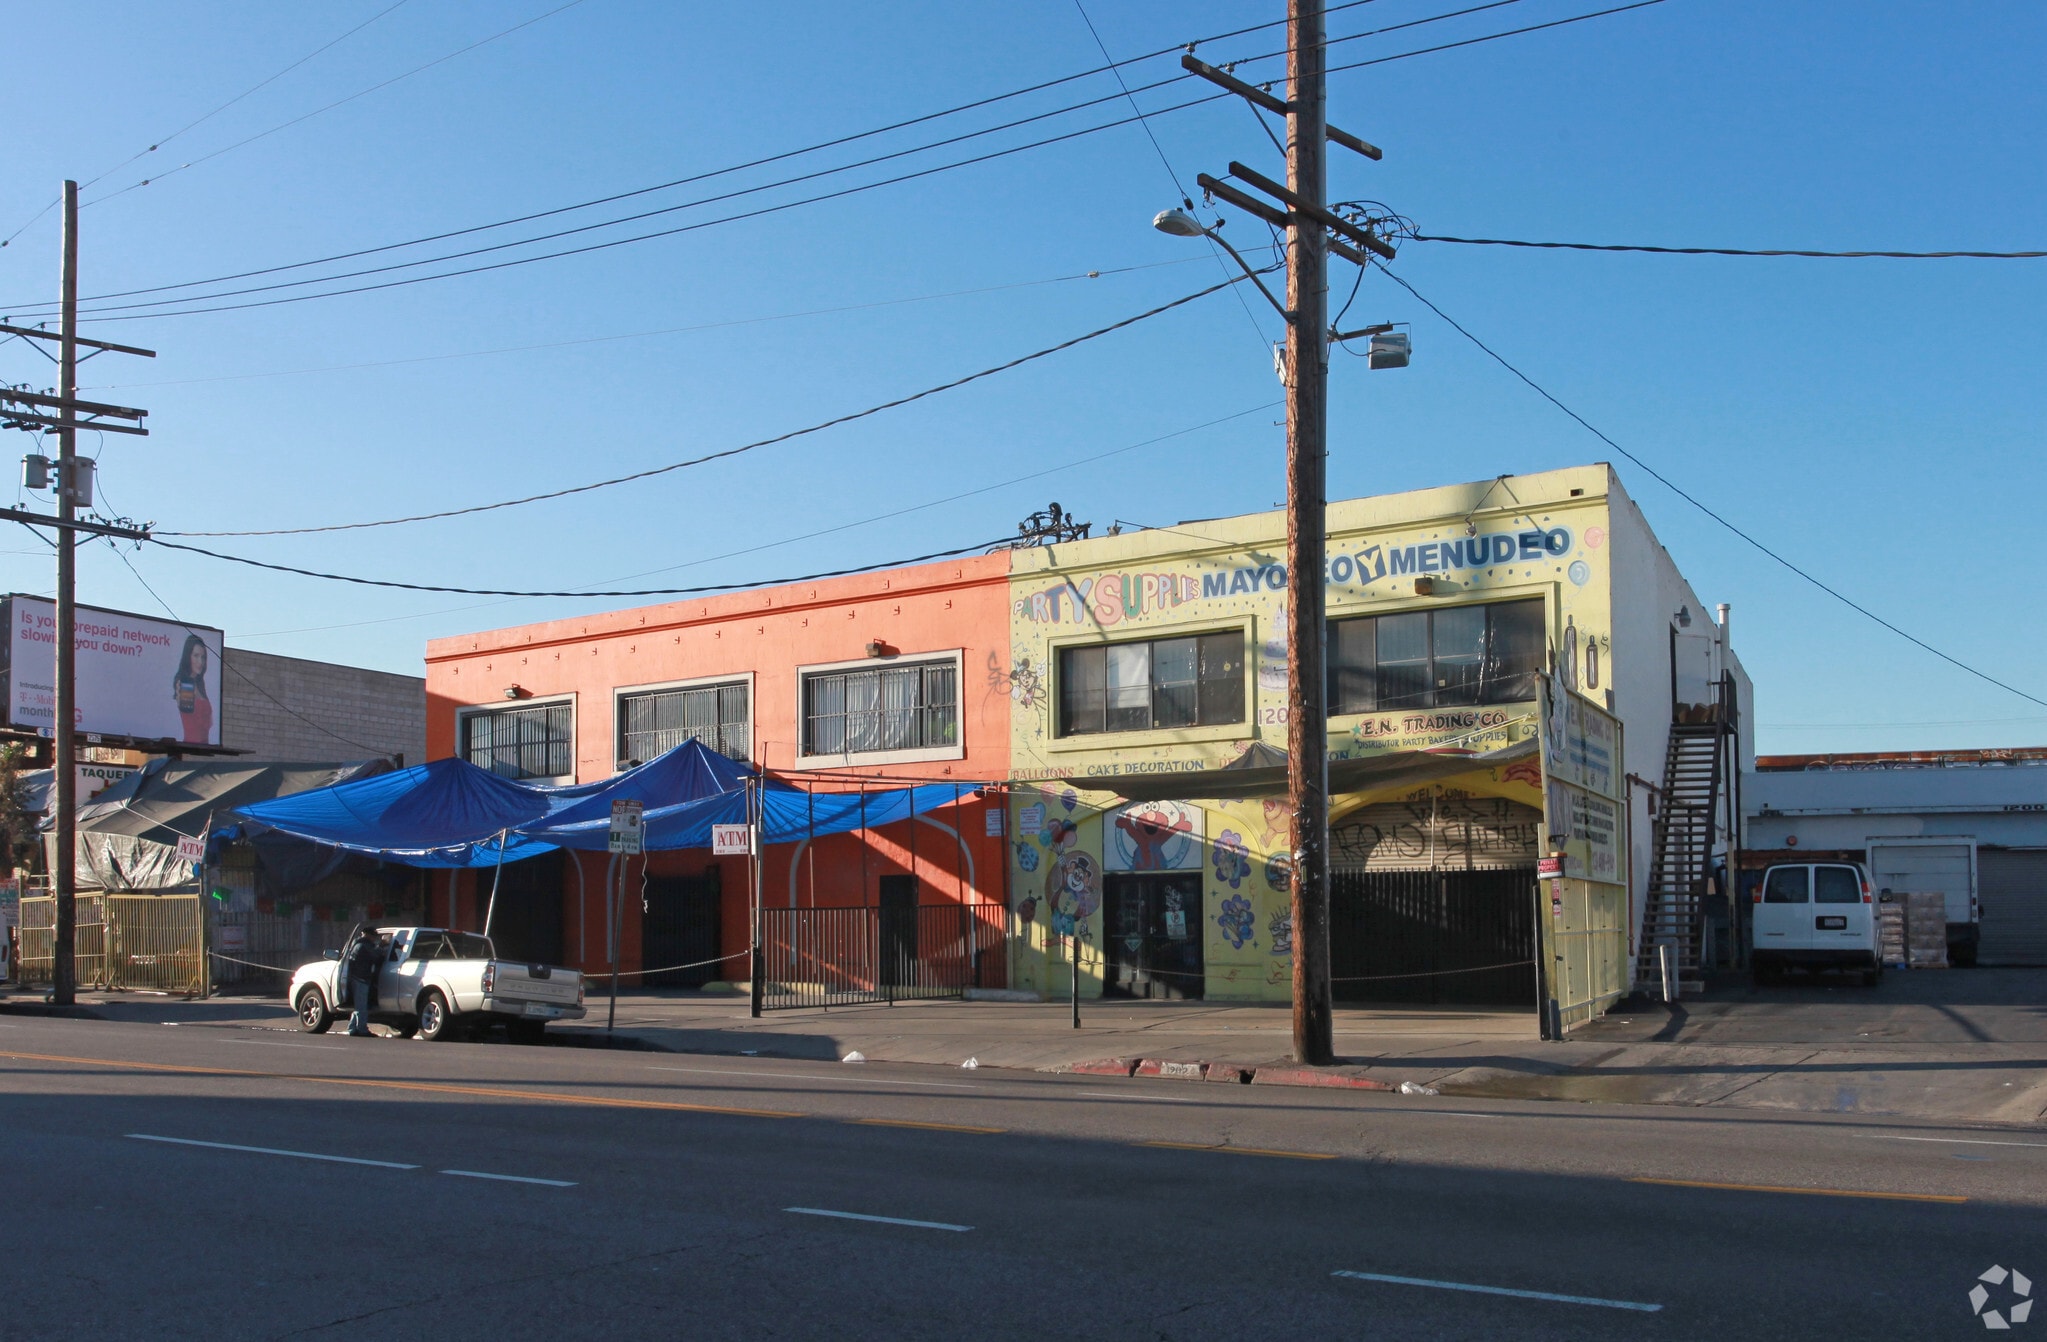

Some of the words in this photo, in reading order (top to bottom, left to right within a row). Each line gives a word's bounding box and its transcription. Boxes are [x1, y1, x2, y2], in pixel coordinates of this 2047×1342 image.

[1012, 577, 1094, 625] PARTY
[1093, 572, 1202, 627] SUPPLIES
[1203, 556, 1353, 600] MAYOO
[1355, 545, 1387, 586] Y
[1389, 527, 1571, 576] MENUDEO
[21, 610, 33, 624] Is
[123, 629, 171, 647] network
[20, 628, 55, 643] slowi
[75, 638, 98, 650] you
[102, 641, 143, 657] down?
[1403, 710, 1476, 733] TRADING
[1402, 736, 1426, 746] PARTY
[1011, 767, 1075, 781] BALLOONS
[1087, 764, 1120, 776] CAKE
[1125, 759, 1205, 774] DECORATION
[1406, 784, 1469, 801] WELCOME
[181, 842, 204, 857] ATM
[717, 831, 748, 847] ATM
